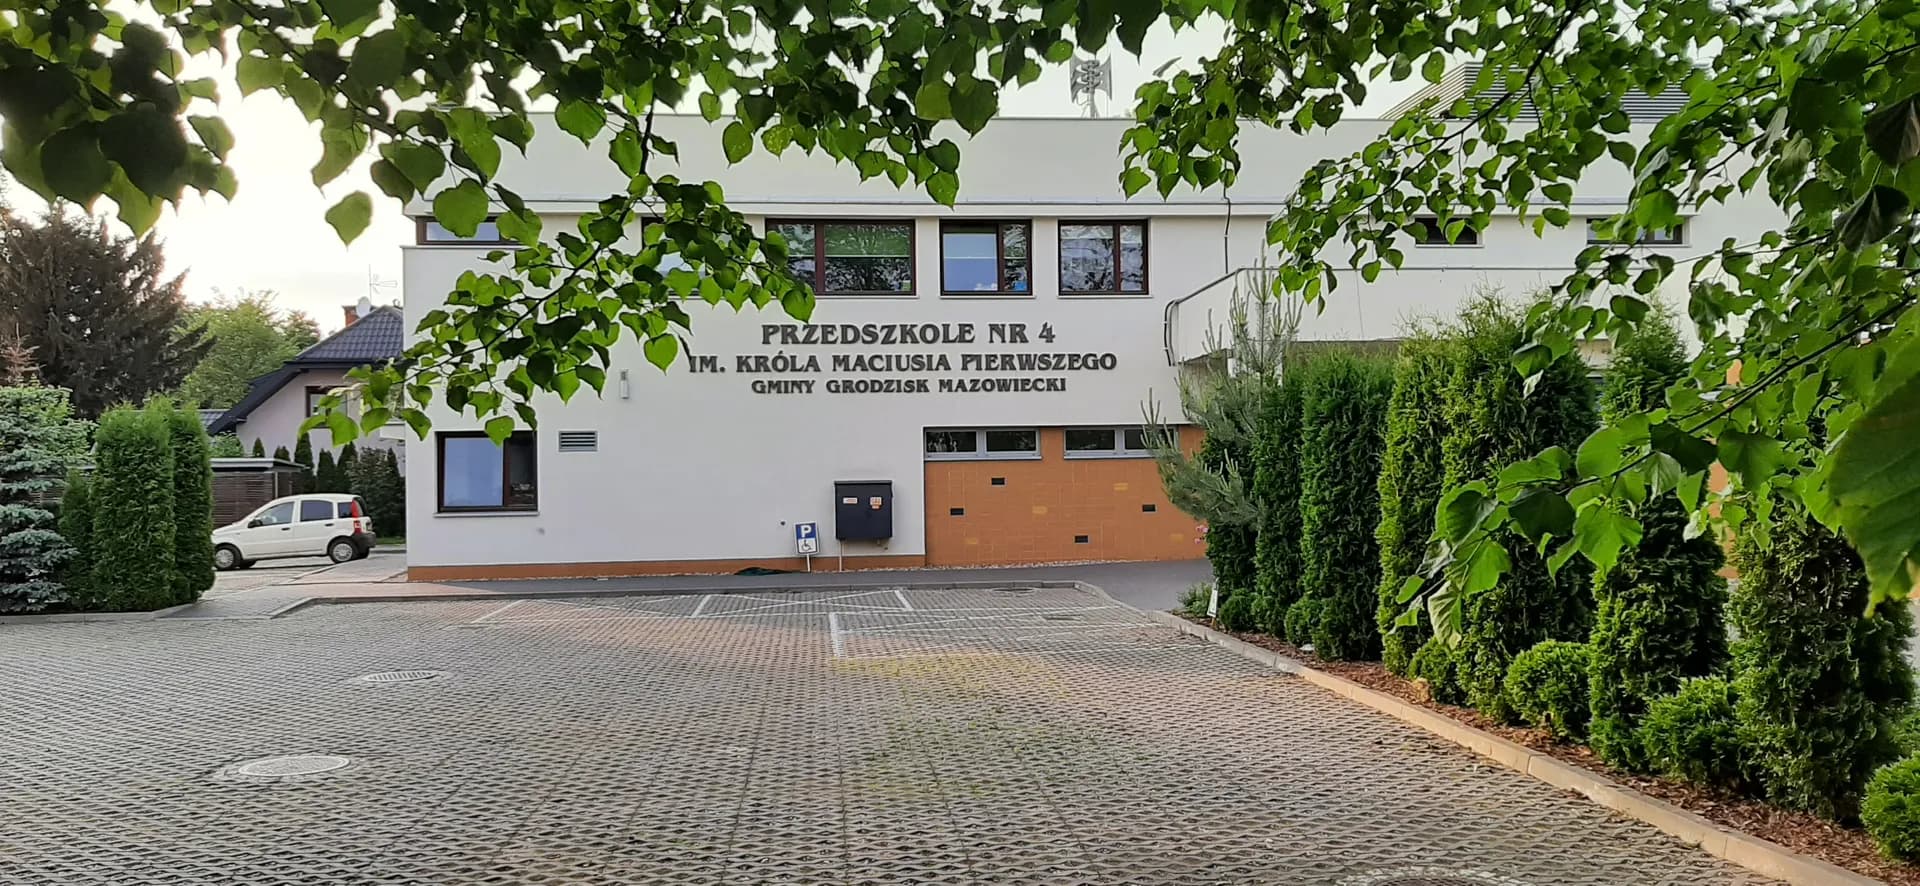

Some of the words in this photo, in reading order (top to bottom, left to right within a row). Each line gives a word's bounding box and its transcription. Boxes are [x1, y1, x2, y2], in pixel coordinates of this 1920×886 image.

[762, 323, 975, 345] PRZEDSZKOLE
[989, 323, 1030, 345] NR
[1038, 322, 1056, 344] 4
[689, 354, 726, 374] IM.
[736, 350, 822, 373] KRÓLA
[832, 353, 952, 373] MACIUSIA
[961, 352, 1117, 372] PIERWSZEGO
[751, 379, 816, 395] GMINY
[826, 378, 930, 394] GRODZISK
[939, 377, 1067, 393] MAZOWIECKI
[801, 525, 812, 538] P
